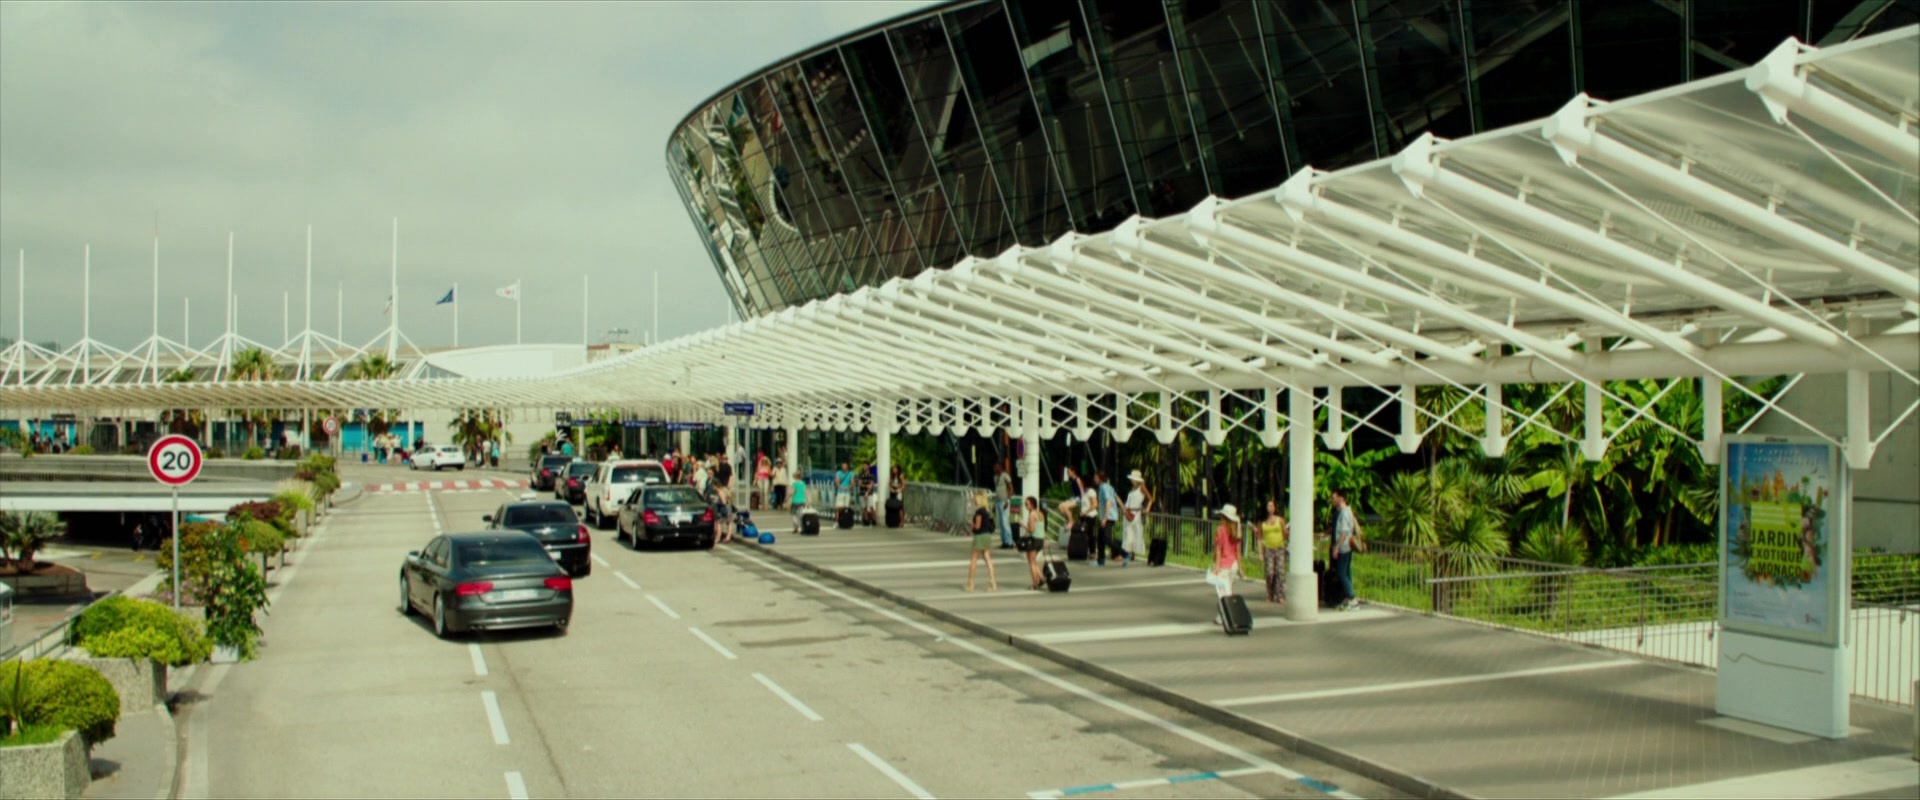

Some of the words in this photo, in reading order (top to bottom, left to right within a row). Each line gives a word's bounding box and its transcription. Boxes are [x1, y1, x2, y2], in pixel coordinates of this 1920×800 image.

[162, 451, 191, 471] 20
[1750, 529, 1801, 549] JARDIN
[1750, 548, 1801, 563] EXOTIQUE
[1757, 561, 1801, 577] MONACO
